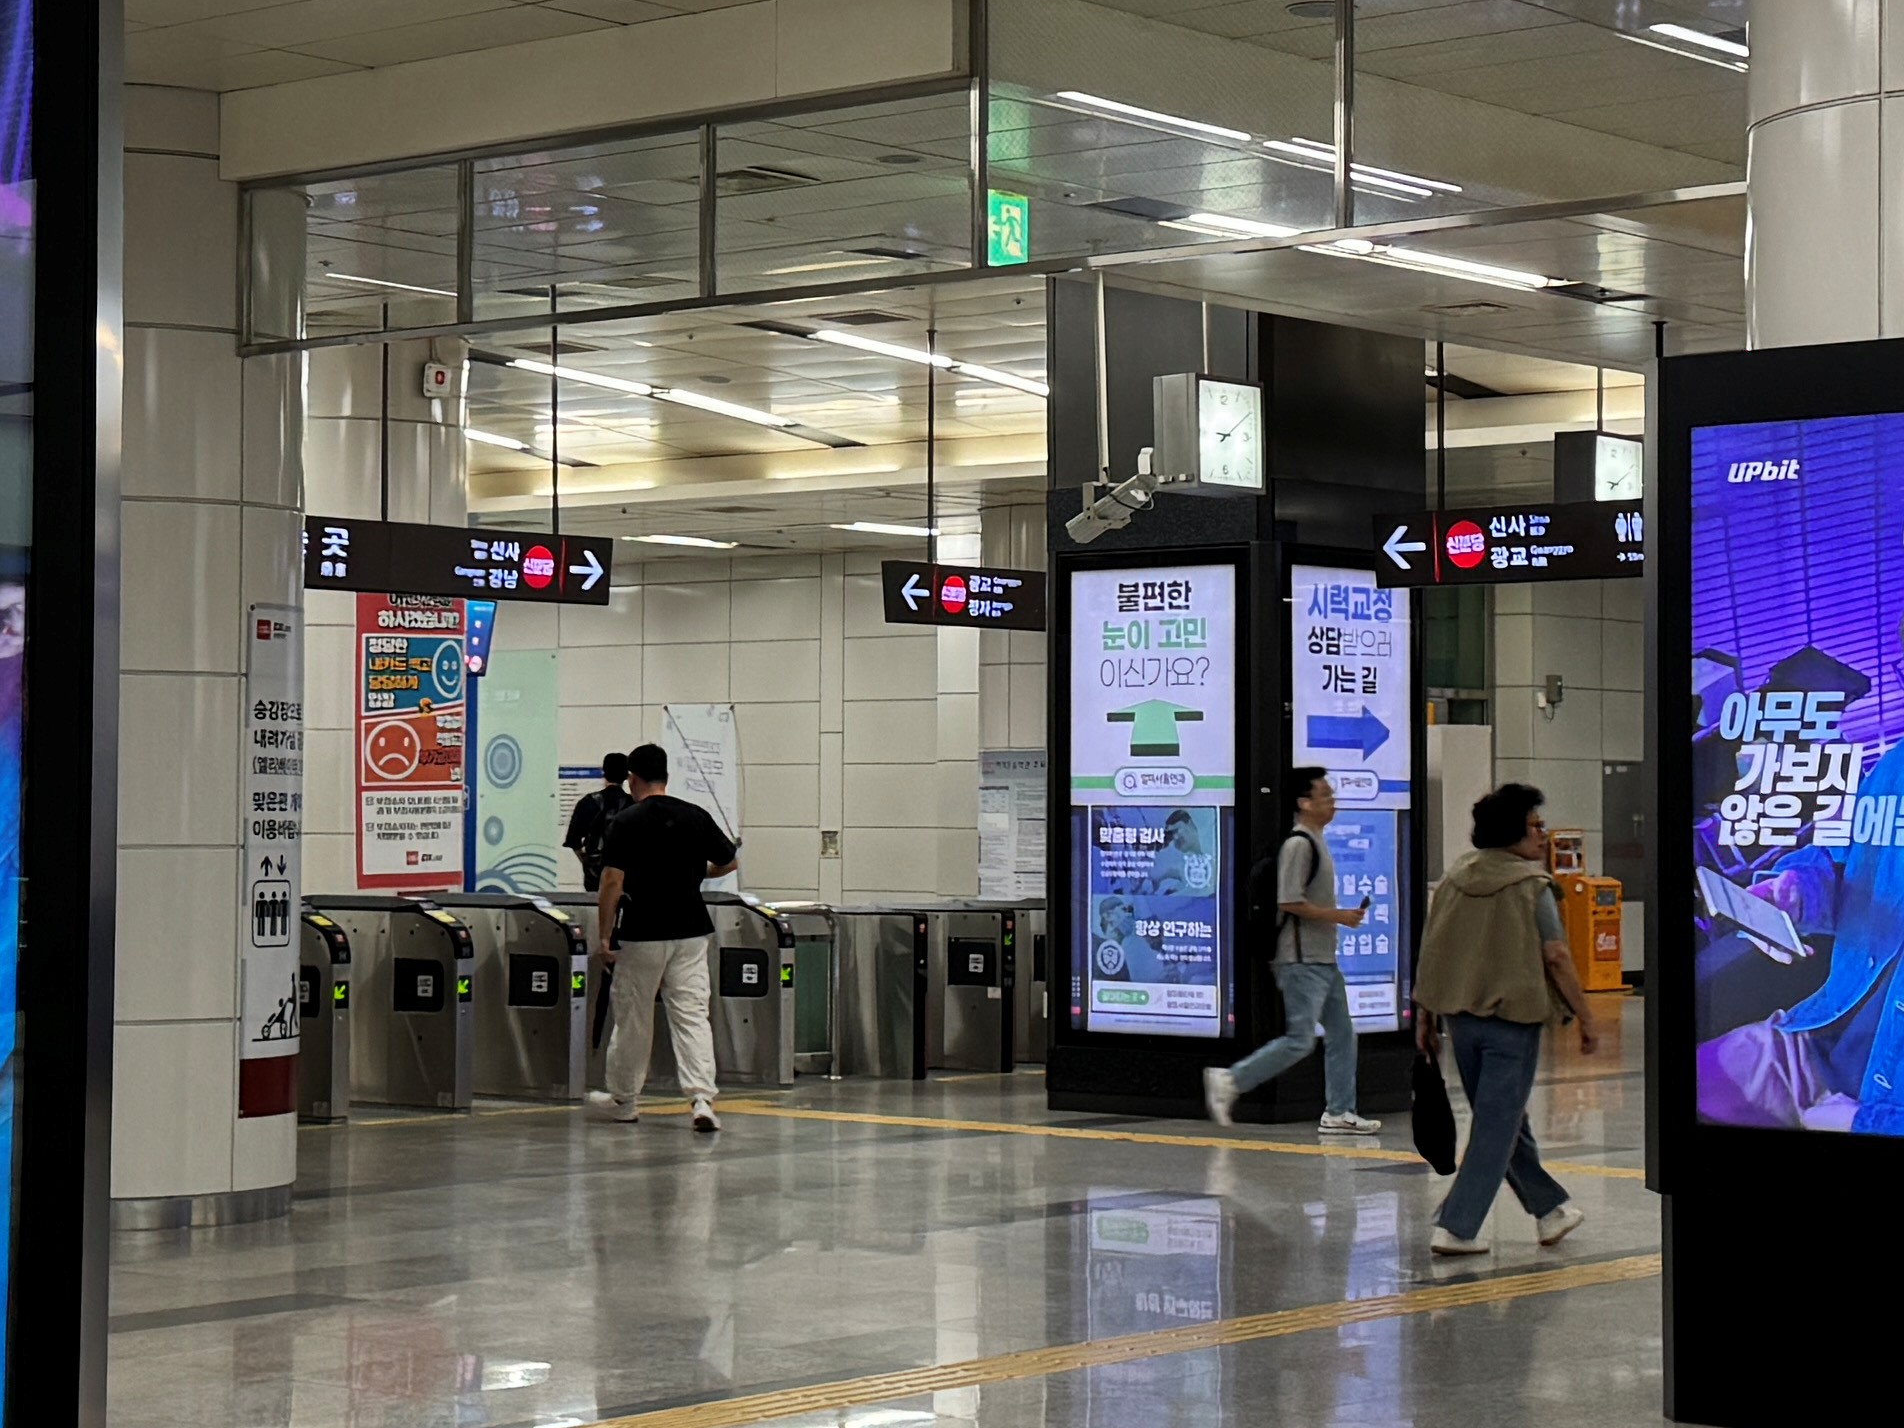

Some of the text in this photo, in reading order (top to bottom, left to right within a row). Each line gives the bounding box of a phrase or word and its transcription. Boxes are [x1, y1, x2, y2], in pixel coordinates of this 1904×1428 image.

[1490, 515, 1526, 537] 신사
[321, 526, 350, 558] 곳
[490, 541, 520, 562] 신사
[1446, 533, 1485, 555] 신분당
[1490, 546, 1529, 569] 광교
[489, 569, 518, 589] 강남
[1117, 580, 1192, 612] 불편한
[1308, 584, 1392, 622] 시력교정
[1102, 617, 1207, 651] 눈이 고민
[1308, 626, 1392, 658] 상담받으러
[1100, 657, 1211, 688] 이신가요?
[1322, 664, 1377, 694] 가는 길
[1719, 691, 1845, 743] 아무도
[1734, 743, 1864, 795] 가보지
[1139, 827, 1165, 844] 검사
[1718, 795, 1802, 847] 않은
[1136, 920, 1212, 938] 항상 연구하는
